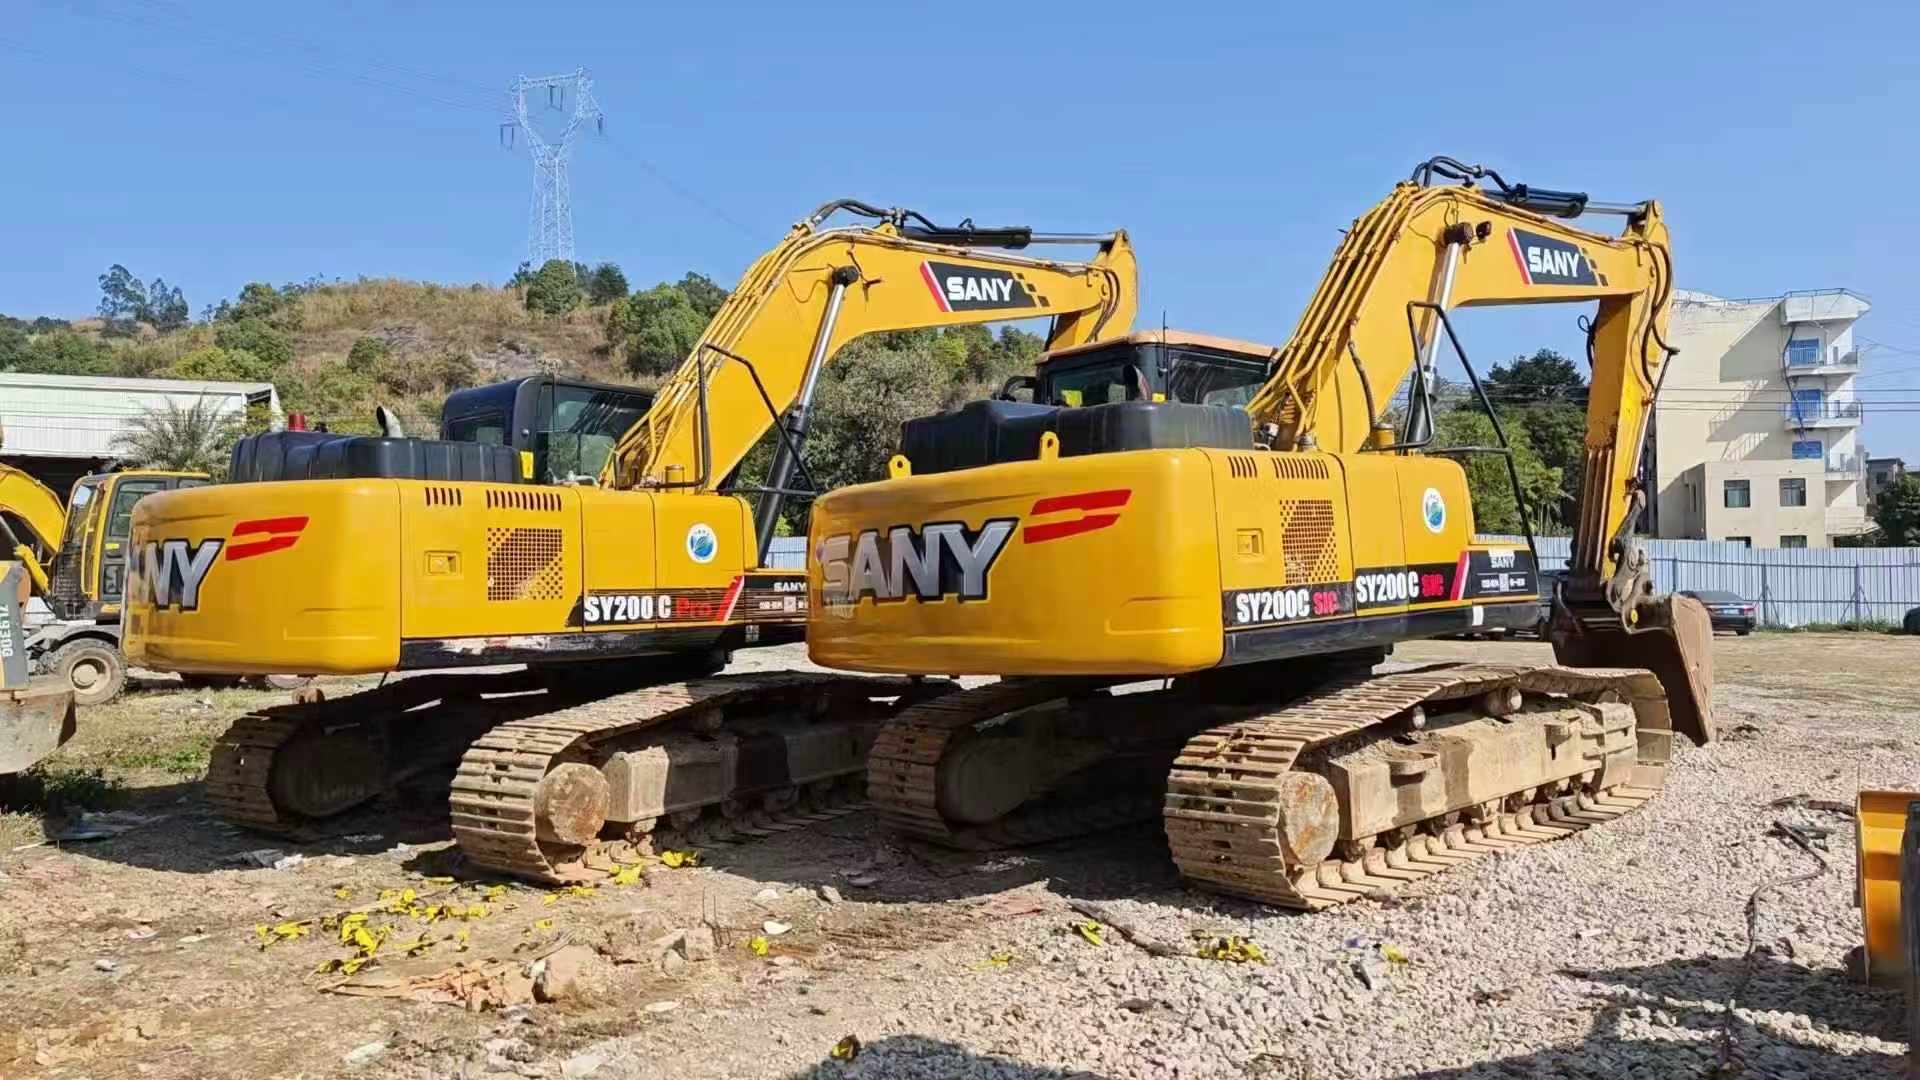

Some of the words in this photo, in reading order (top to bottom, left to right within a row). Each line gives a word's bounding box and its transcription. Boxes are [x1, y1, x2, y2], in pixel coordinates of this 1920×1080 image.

[1527, 246, 1580, 278] SANY
[946, 276, 1014, 301] SANY
[821, 516, 1020, 604] SANY
[1236, 588, 1310, 623] SY200C
[1312, 590, 1339, 616] SIC
